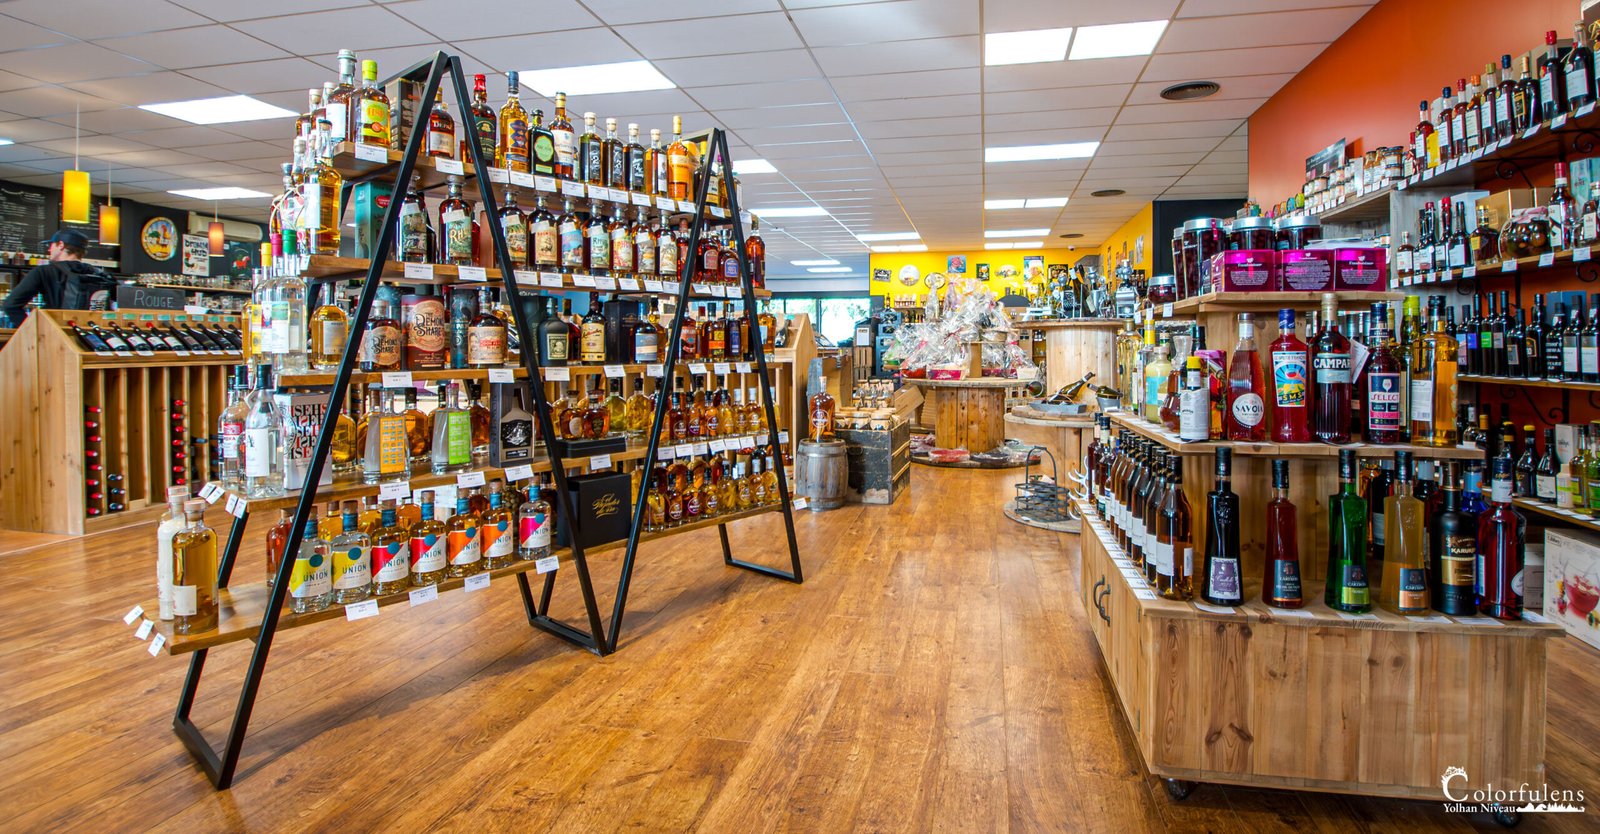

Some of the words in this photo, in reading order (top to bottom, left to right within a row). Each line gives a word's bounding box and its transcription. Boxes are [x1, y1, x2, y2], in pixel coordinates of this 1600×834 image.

[134, 289, 174, 308] ROUGE
[419, 549, 442, 559] UNION
[342, 564, 367, 575] UNION
[303, 570, 329, 582] UNION
